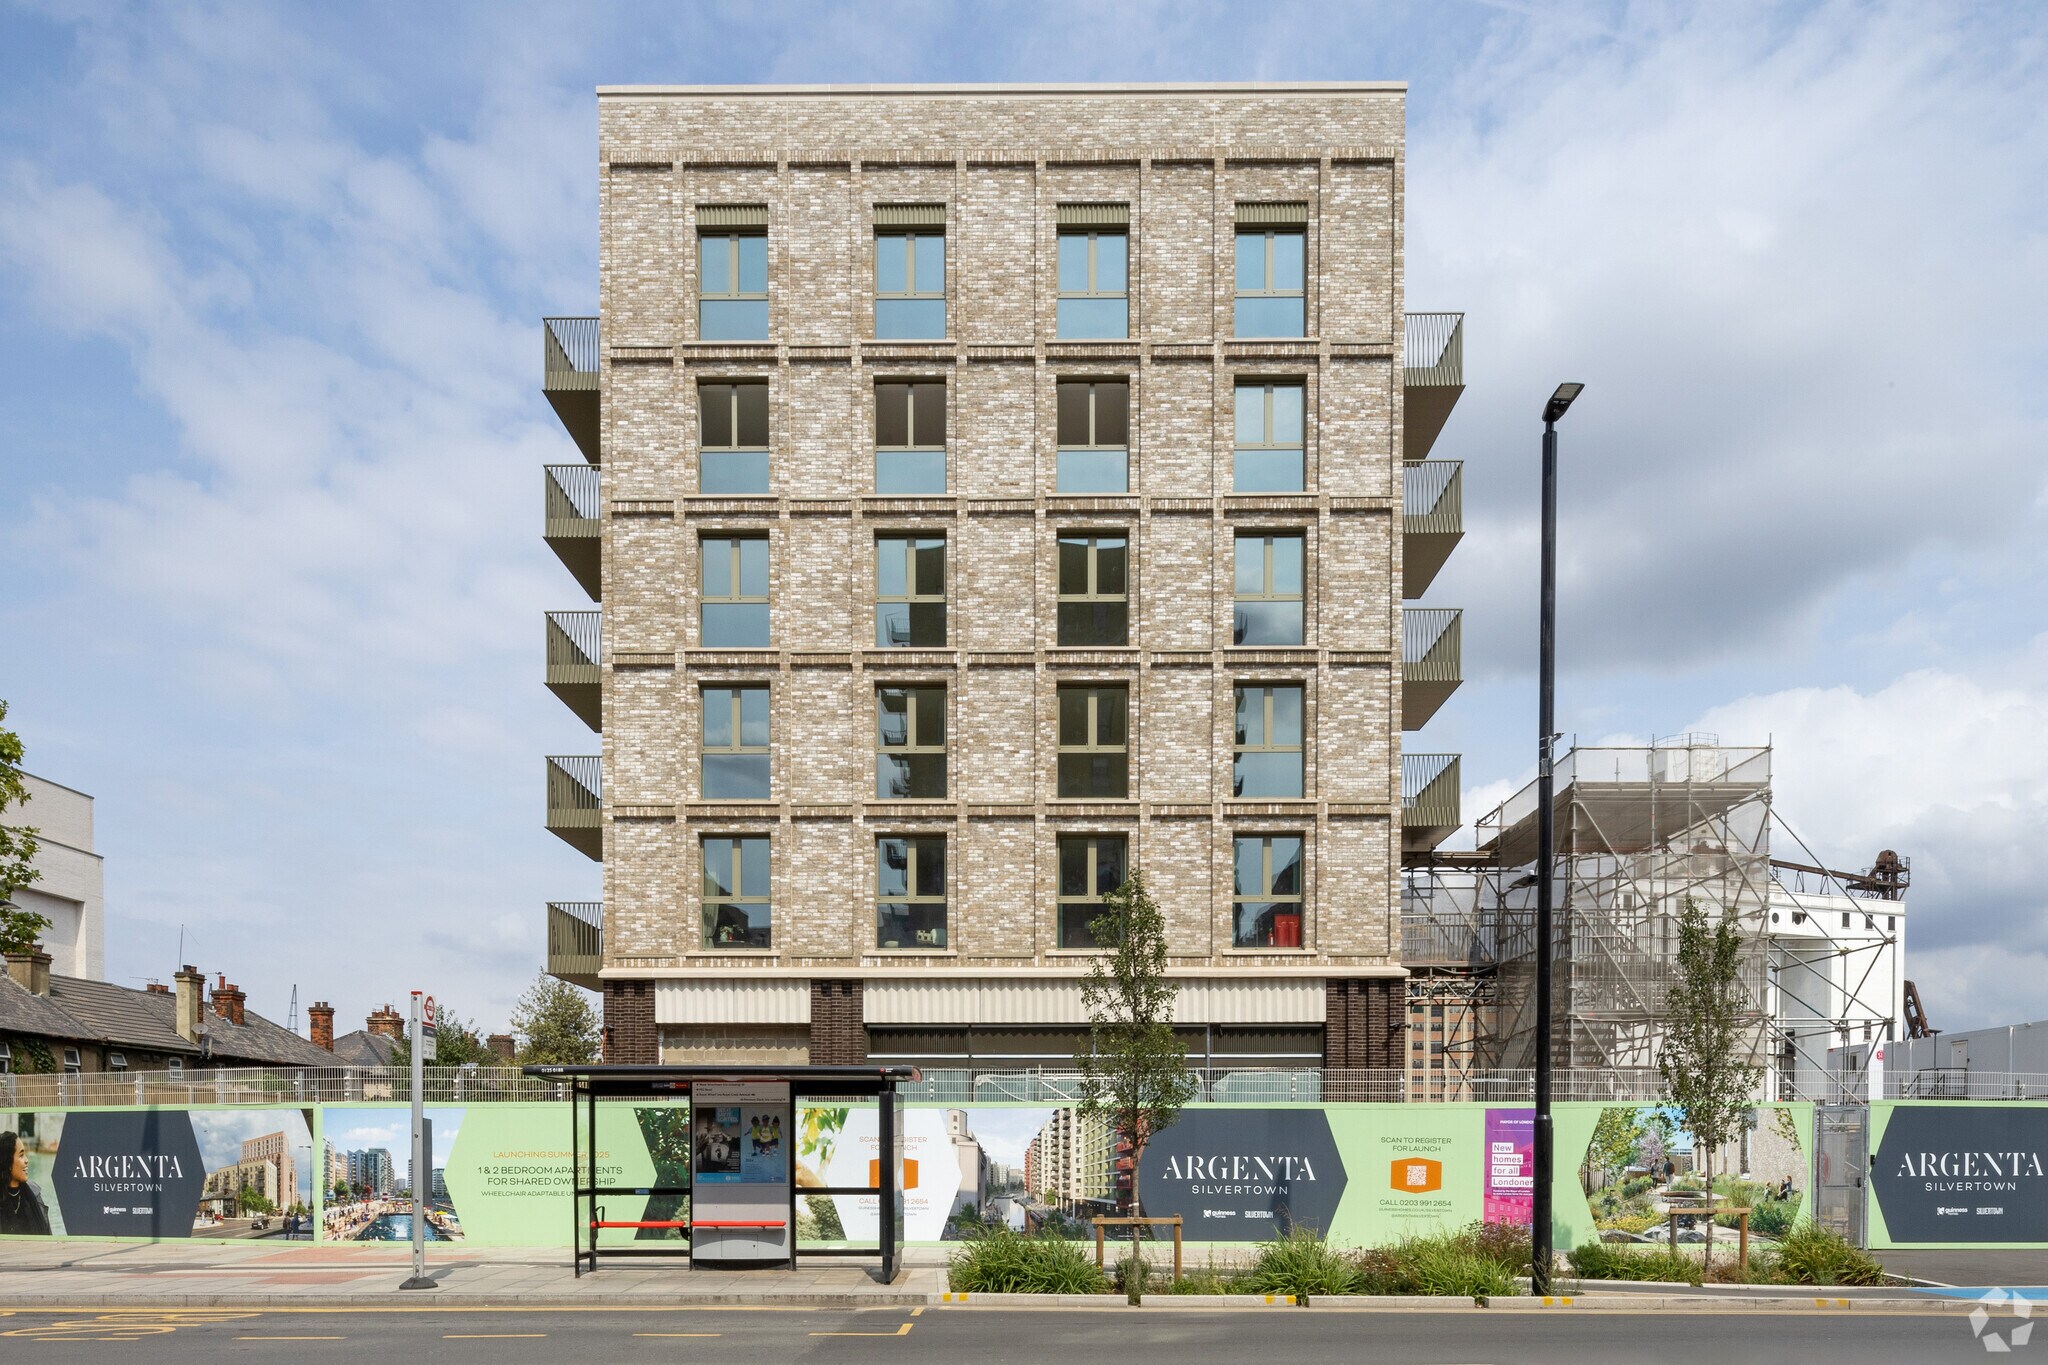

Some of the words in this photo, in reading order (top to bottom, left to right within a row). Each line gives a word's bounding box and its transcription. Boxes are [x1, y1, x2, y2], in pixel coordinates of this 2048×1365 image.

[73, 1156, 184, 1178] ARGENTA
[1162, 1155, 1316, 1180] ARGENTA
[1897, 1152, 2044, 1176] ARGENTA
[94, 1183, 162, 1192] SILVERTOWN
[1192, 1184, 1288, 1194] SILVERTOWN
[1925, 1182, 2016, 1192] SILVERTOWN
